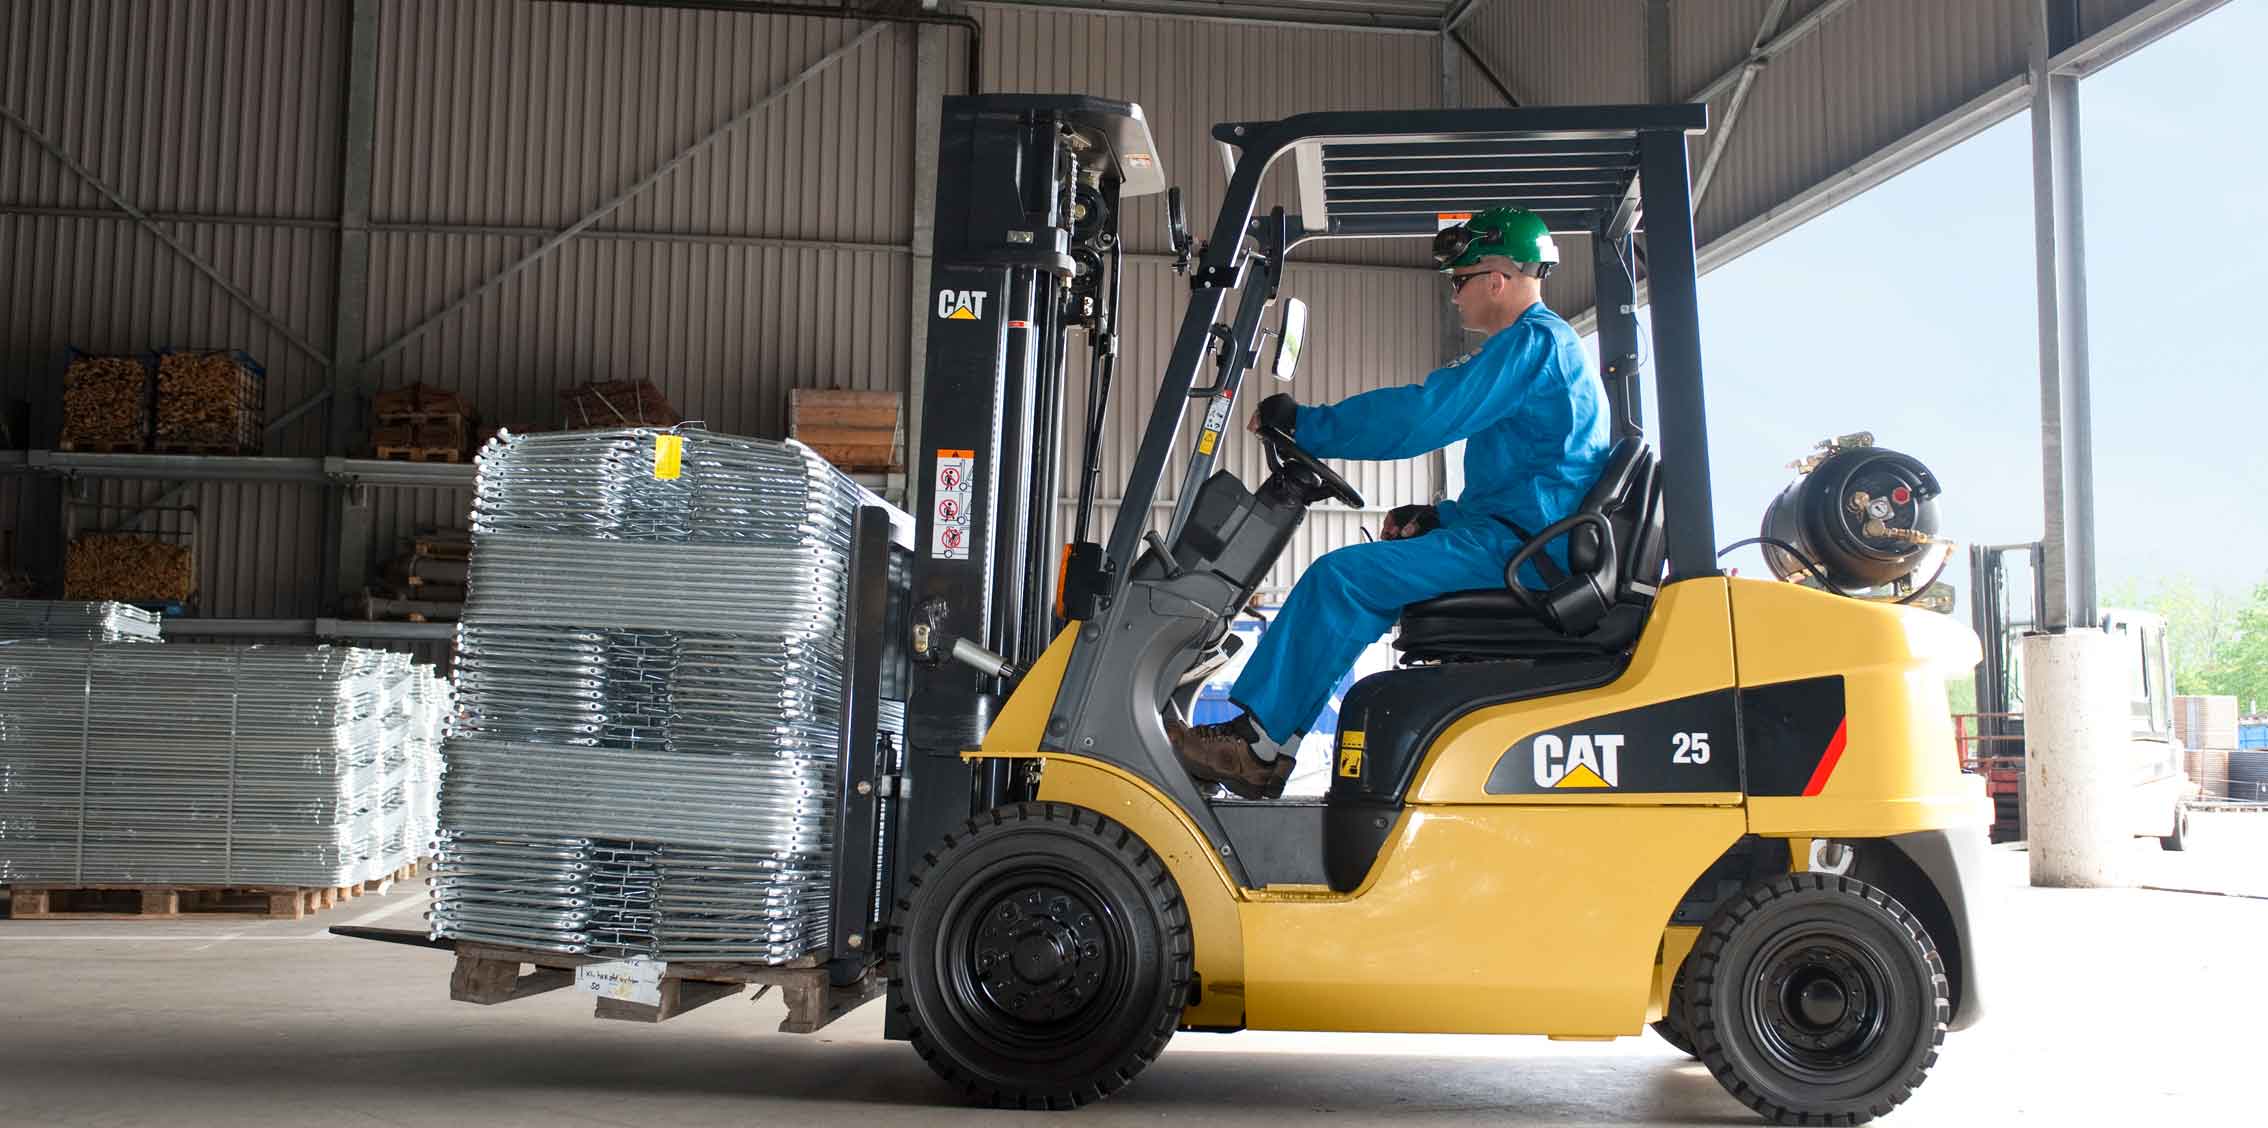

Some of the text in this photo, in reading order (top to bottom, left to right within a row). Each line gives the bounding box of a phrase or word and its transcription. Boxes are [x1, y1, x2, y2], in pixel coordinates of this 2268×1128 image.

[938, 289, 987, 320] CAT
[1533, 732, 1710, 788] CAT 25
